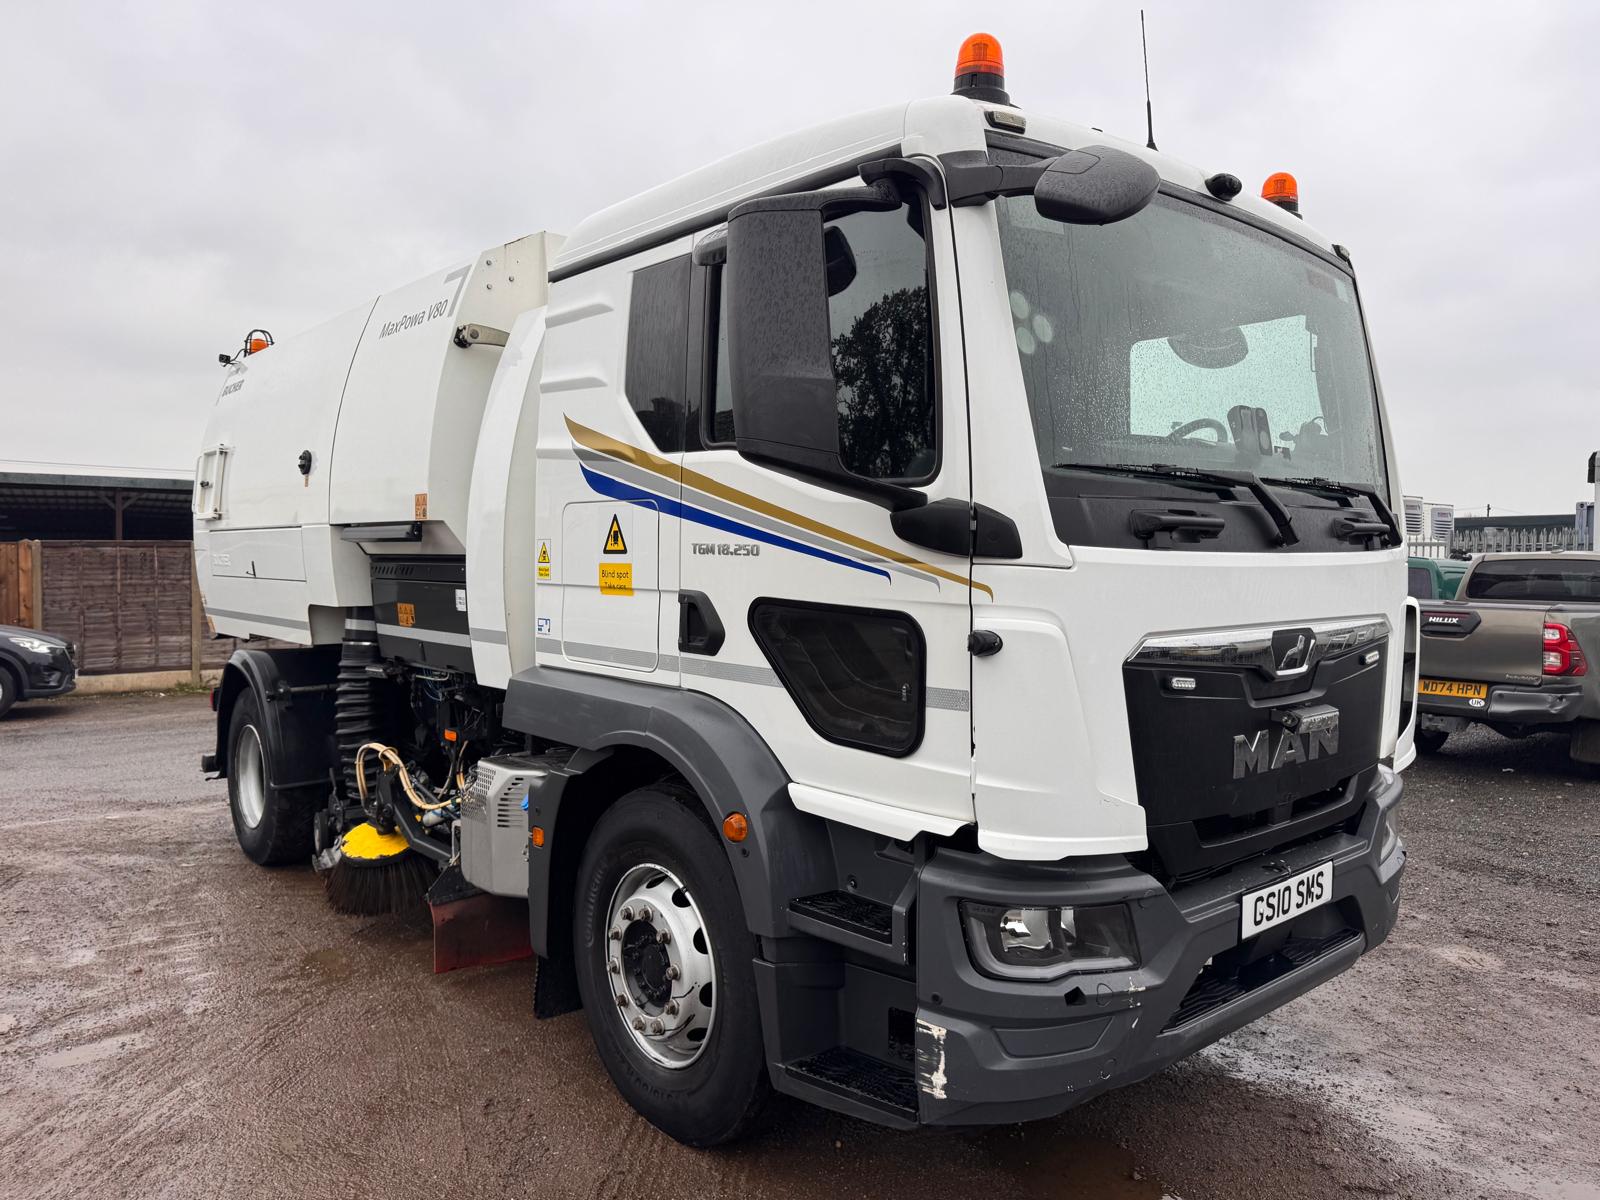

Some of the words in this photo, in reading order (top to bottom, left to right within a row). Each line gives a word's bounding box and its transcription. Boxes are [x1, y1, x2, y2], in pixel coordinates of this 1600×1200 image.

[379, 310, 426, 340] MaxPowa
[427, 299, 449, 321] V80
[692, 543, 716, 555] TGM
[717, 543, 760, 556] 18.250
[601, 569, 615, 578] Blind
[616, 571, 629, 580] spot
[1428, 616, 1459, 624] HILUX
[1422, 681, 1453, 694] WD74
[1456, 683, 1482, 696] HPN
[1233, 723, 1339, 779] MAN
[1253, 885, 1292, 927] GS10
[1295, 870, 1324, 909] SMS
